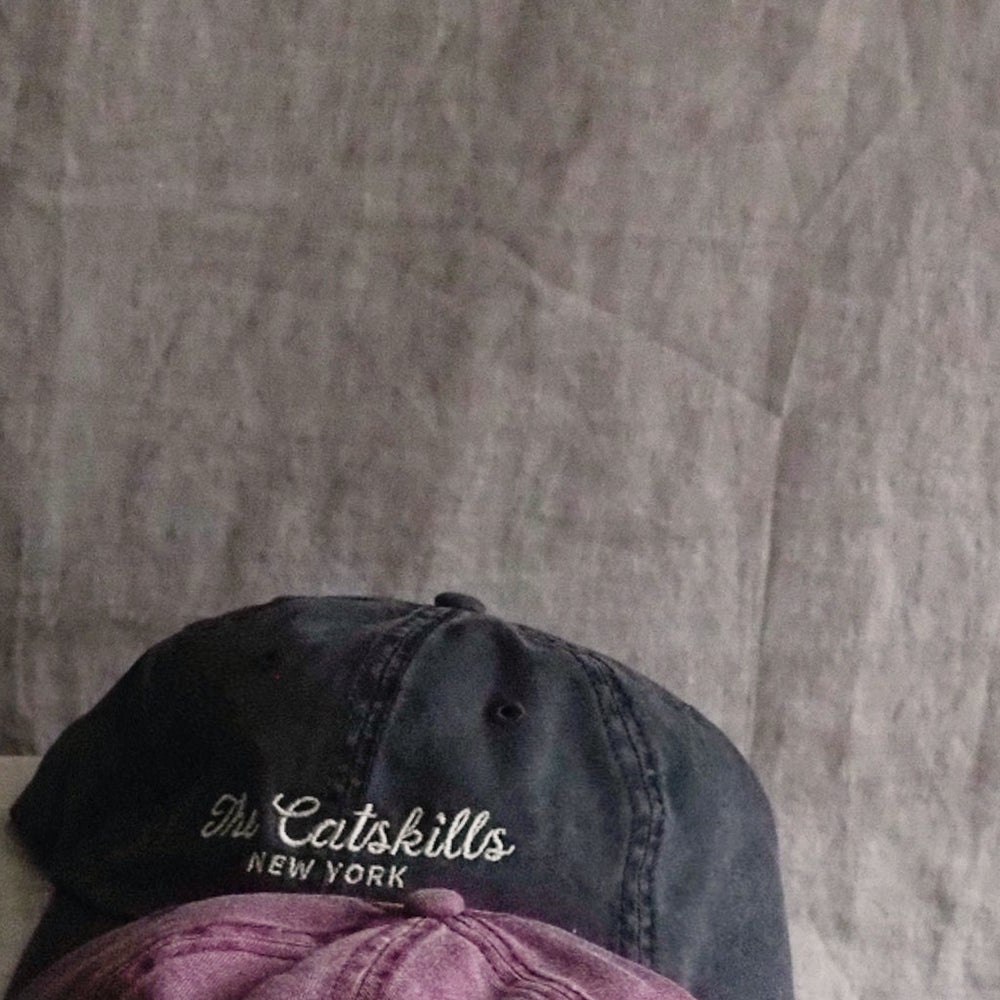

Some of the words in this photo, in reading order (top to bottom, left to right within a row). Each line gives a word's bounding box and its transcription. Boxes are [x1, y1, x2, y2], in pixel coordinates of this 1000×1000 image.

[272, 793, 516, 862] Catskills
[246, 851, 316, 880] NEW
[326, 861, 409, 888] YORK
